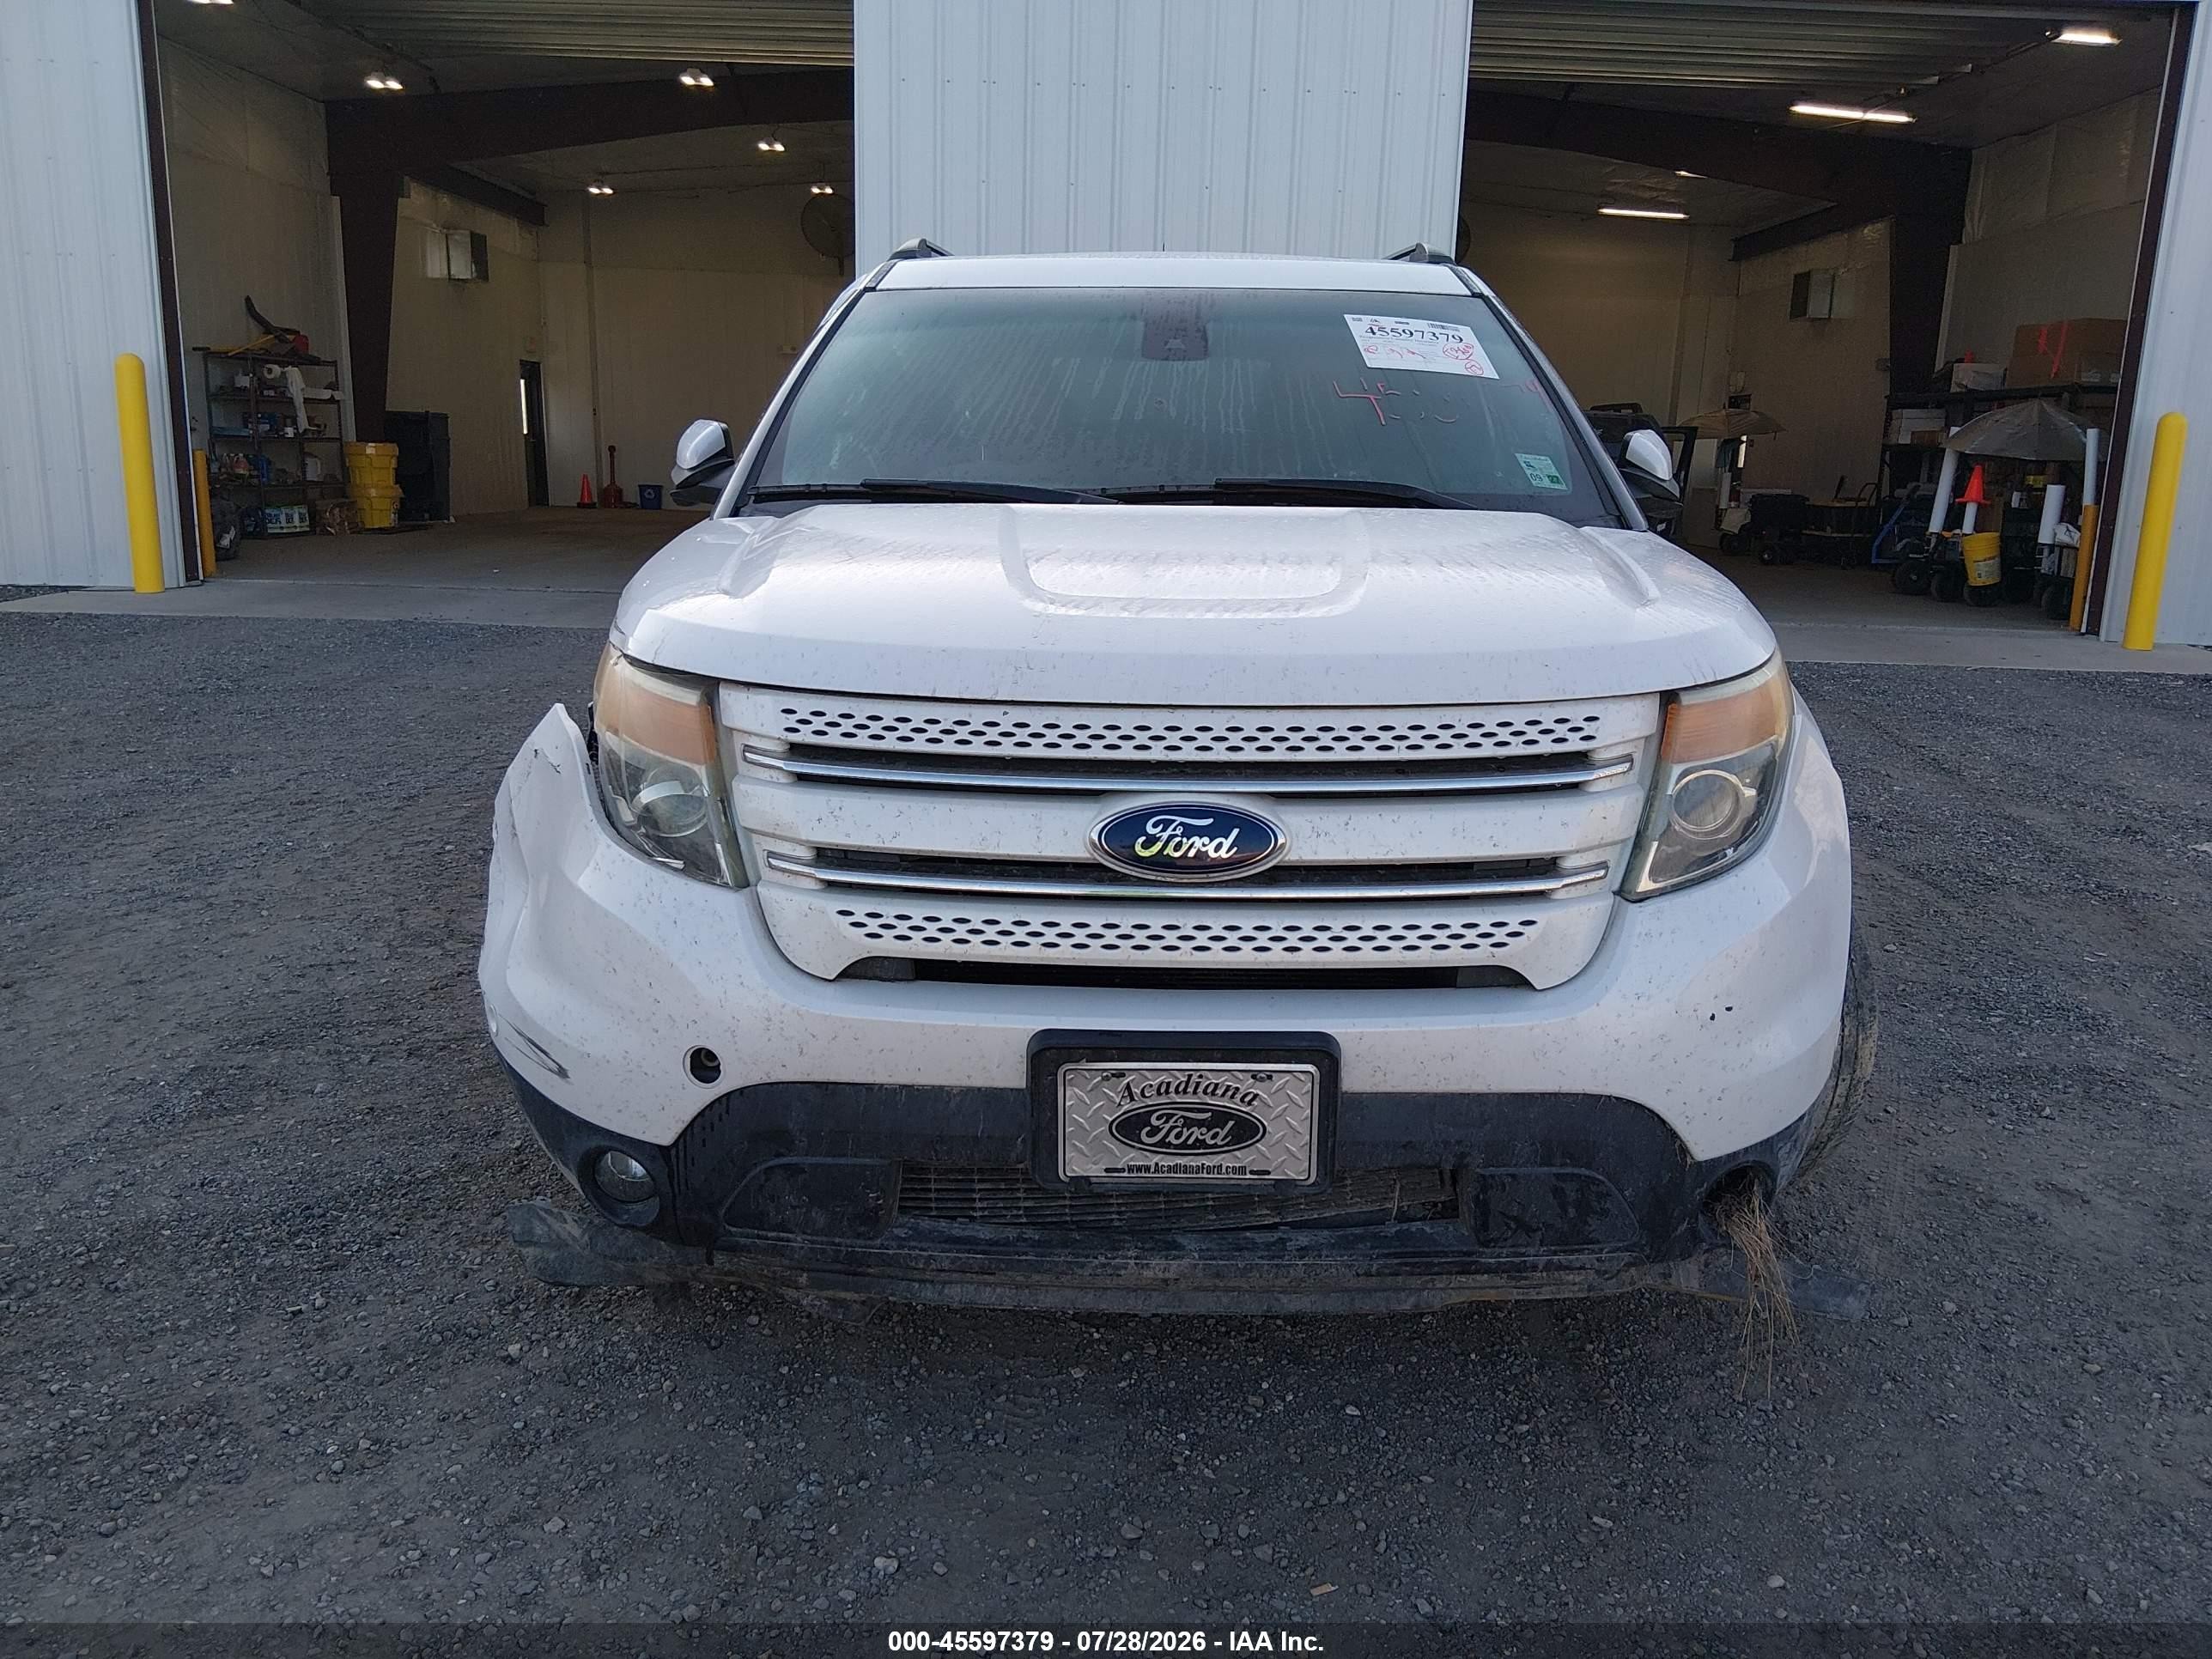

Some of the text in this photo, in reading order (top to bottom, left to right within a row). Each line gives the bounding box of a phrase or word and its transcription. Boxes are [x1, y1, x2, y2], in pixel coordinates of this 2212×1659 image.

[1365, 326, 1463, 343] 45597379
[1134, 815, 1240, 859] Ford
[1117, 1073, 1261, 1107] Acadiana
[1140, 1109, 1236, 1146] Ford
[1127, 1162, 1248, 1176] www.AcadianaFord.com
